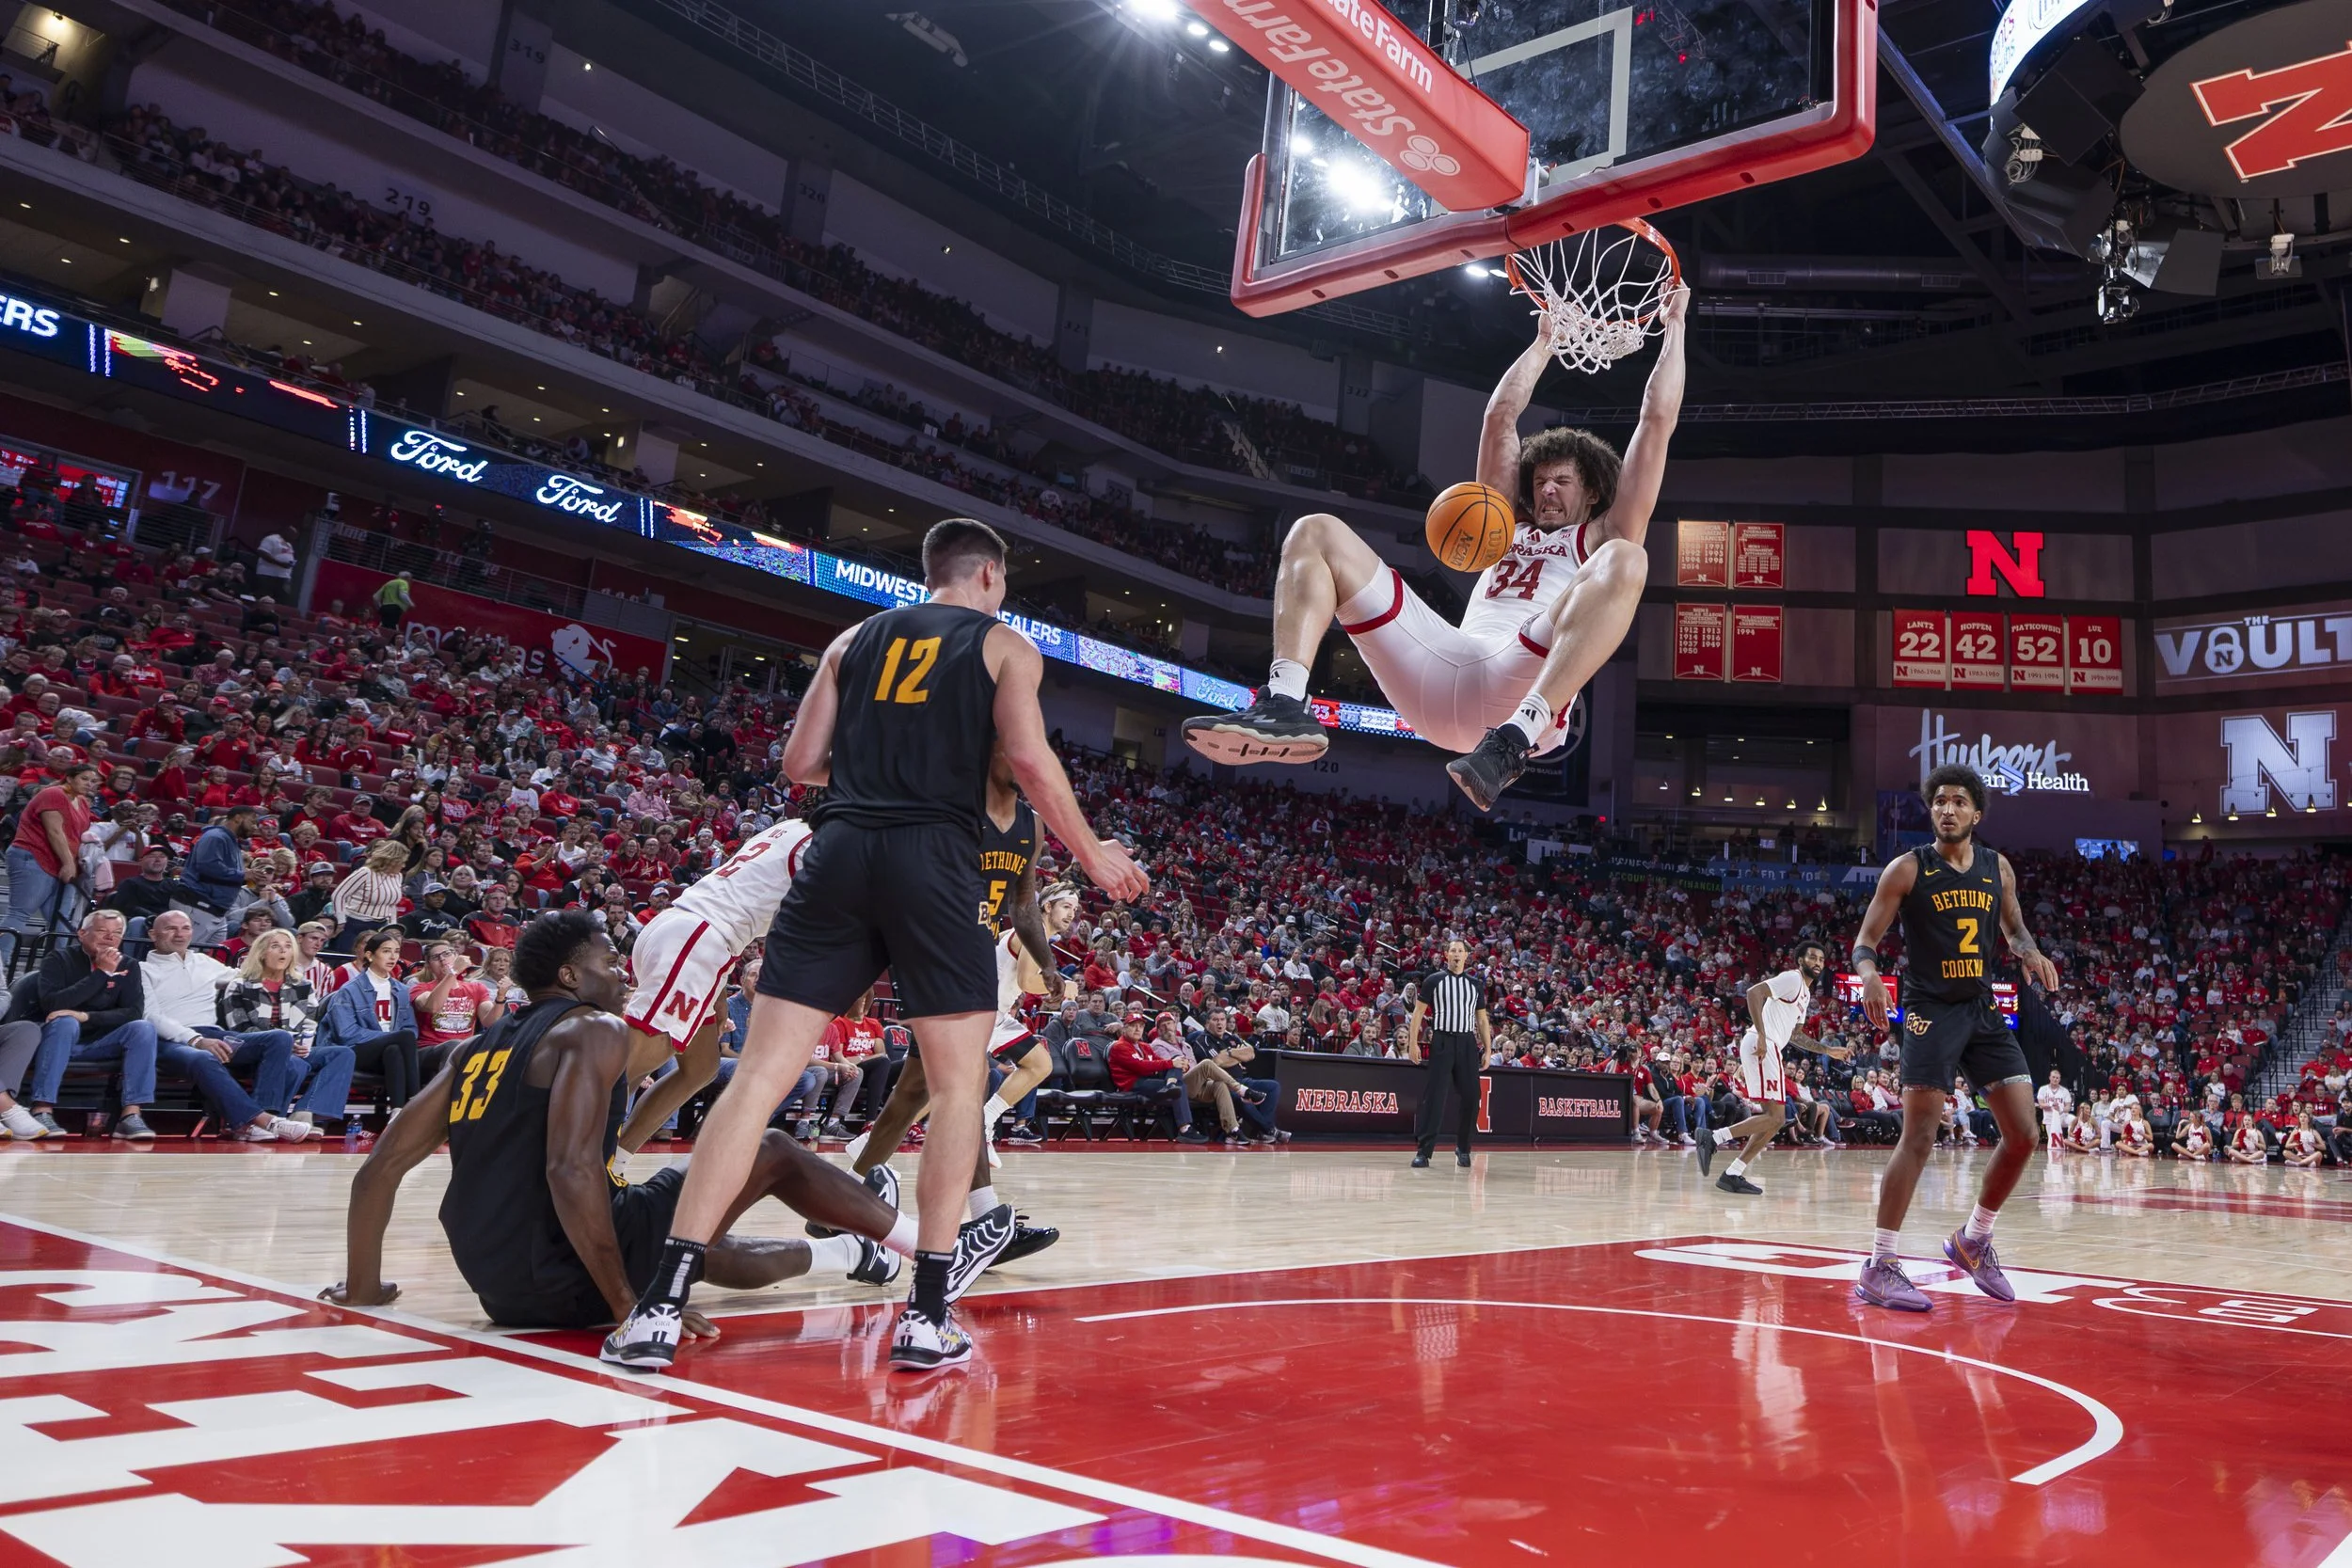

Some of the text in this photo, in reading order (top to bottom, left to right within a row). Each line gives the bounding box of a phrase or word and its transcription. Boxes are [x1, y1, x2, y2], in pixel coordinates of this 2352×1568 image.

[508, 36, 547, 65] 319
[385, 187, 431, 217] 219
[390, 430, 488, 483] Ford
[161, 470, 222, 499] 117
[536, 474, 623, 523] Ford
[1506, 542, 1568, 558] BRASKA
[1965, 529, 2045, 598] N
[834, 559, 929, 604] MIDWEST
[1485, 559, 1546, 601] 34
[1907, 621, 1935, 630] LANTZ
[1960, 623, 1993, 632] HOPPEN
[2011, 623, 2061, 634] PIATKOWSKI
[2088, 625, 2102, 633] LUE
[2243, 614, 2271, 626] THE
[1899, 631, 1941, 658] 22
[1956, 633, 1996, 660] 42
[2016, 636, 2058, 662] 52
[2078, 638, 2112, 664] 10
[874, 636, 942, 704] 12
[1693, 665, 1705, 674] N
[1751, 667, 1762, 676] N
[1896, 665, 1909, 677] N
[1953, 667, 1966, 678] N
[2013, 670, 2026, 681] N
[2073, 671, 2086, 683] N
[1196, 677, 1239, 709] Ford
[1909, 708, 2073, 790] Huskers
[2219, 709, 2338, 816] N
[2026, 771, 2090, 792] Health
[988, 879, 1008, 916] 5
[1931, 889, 1994, 912] BETHUNE
[420, 918, 452, 931] Fender
[1956, 917, 1979, 954] 2
[662, 990, 700, 1022] N
[1906, 1012, 1933, 1036] BCU
[890, 1028, 909, 1046] N
[1074, 1040, 1092, 1057] N
[450, 1048, 514, 1123] 33
[1766, 1079, 1778, 1092] N
[1295, 1087, 1399, 1114] NEBRASKA
[1538, 1097, 1622, 1118] BASKETBALL
[2051, 1132, 2064, 1148] N
[905, 1323, 912, 1333] 2
